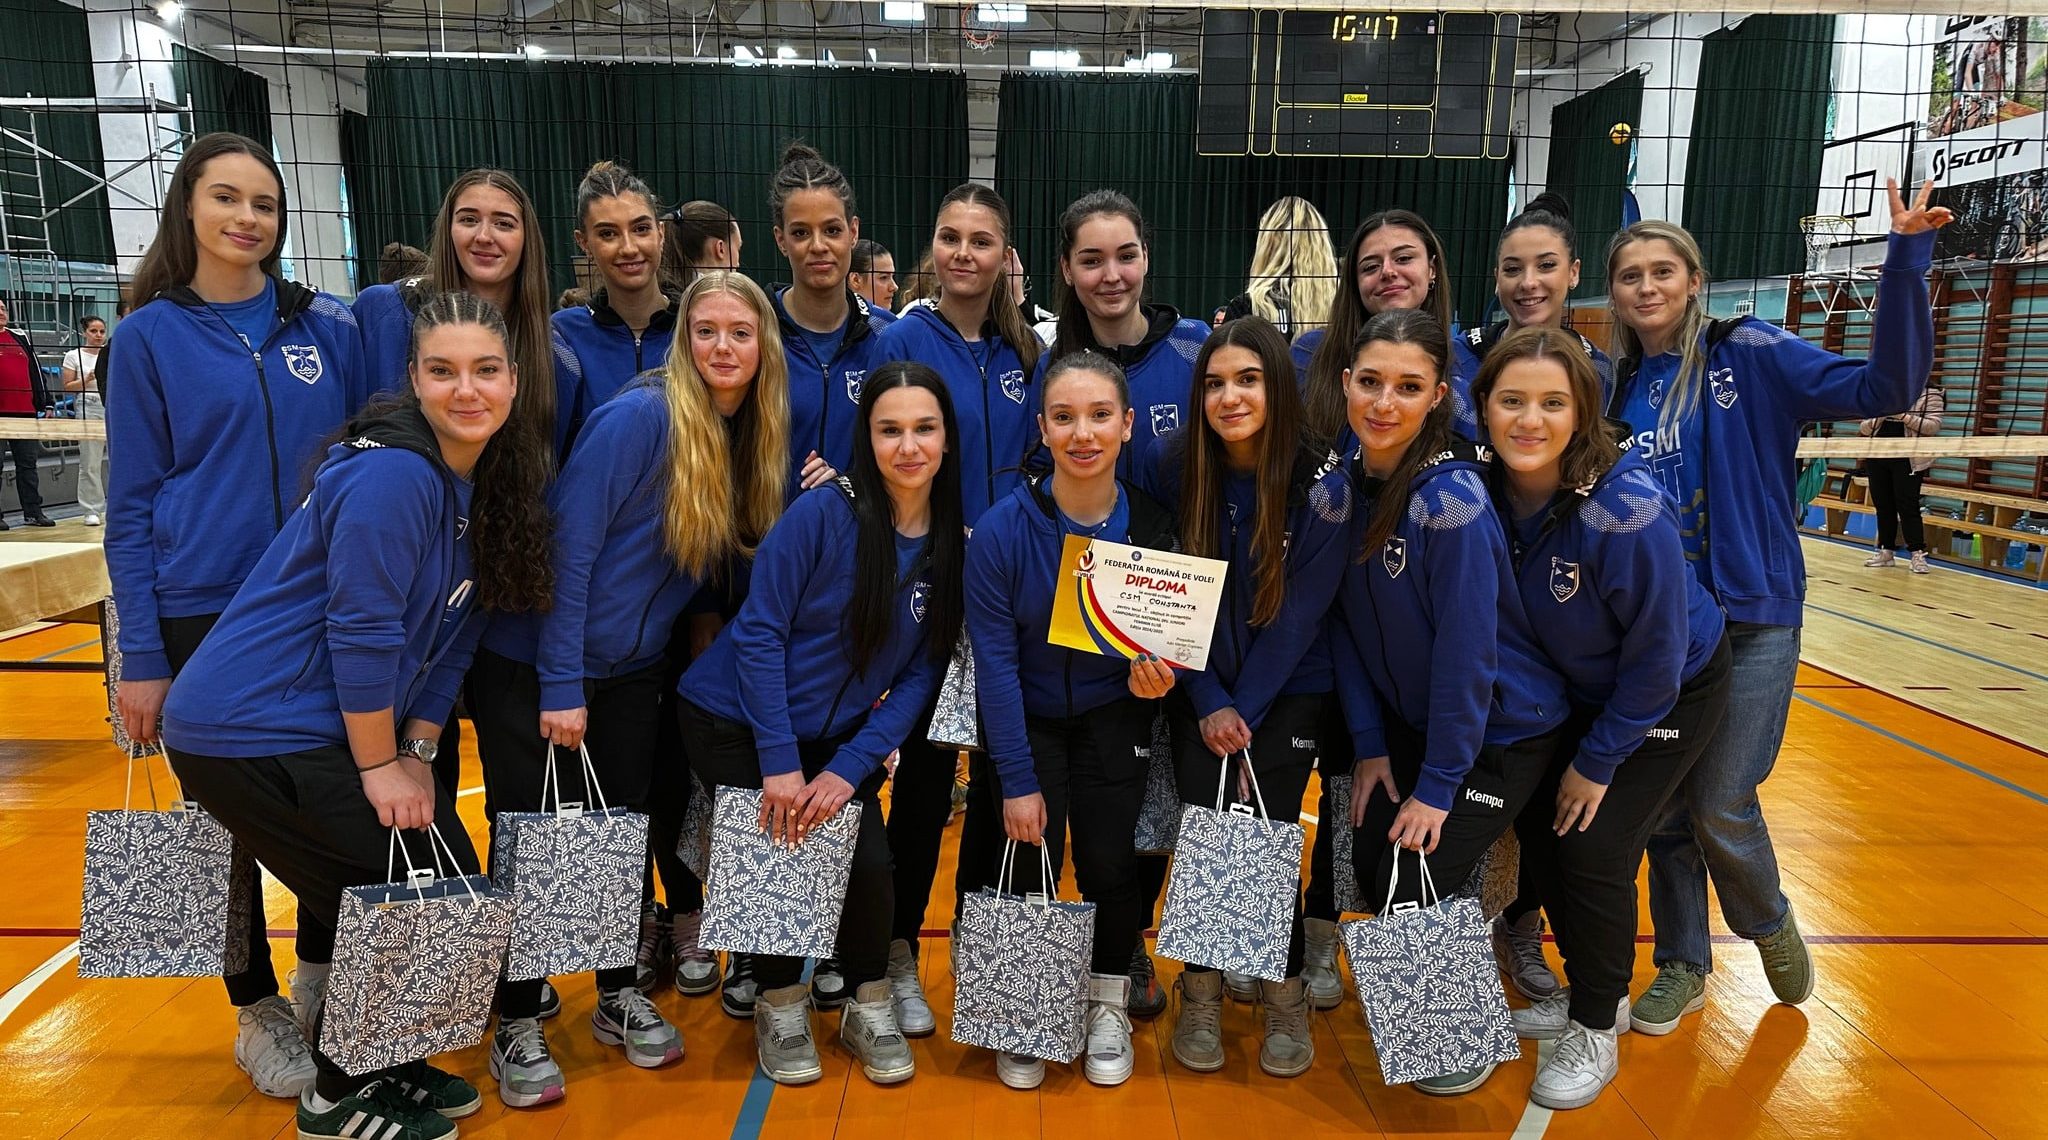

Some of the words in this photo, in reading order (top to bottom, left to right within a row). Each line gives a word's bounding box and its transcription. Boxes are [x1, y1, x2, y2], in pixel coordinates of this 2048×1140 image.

[1332, 15, 1398, 41] 15:47
[1948, 138, 2029, 170] SCOTT
[1637, 421, 1681, 459] SM
[1125, 573, 1188, 596] DIPLOMA
[1181, 572, 1192, 580] DE
[1193, 574, 1215, 584] VOLEI
[1120, 592, 1141, 602] CSM
[1465, 787, 1504, 808] Kempa
